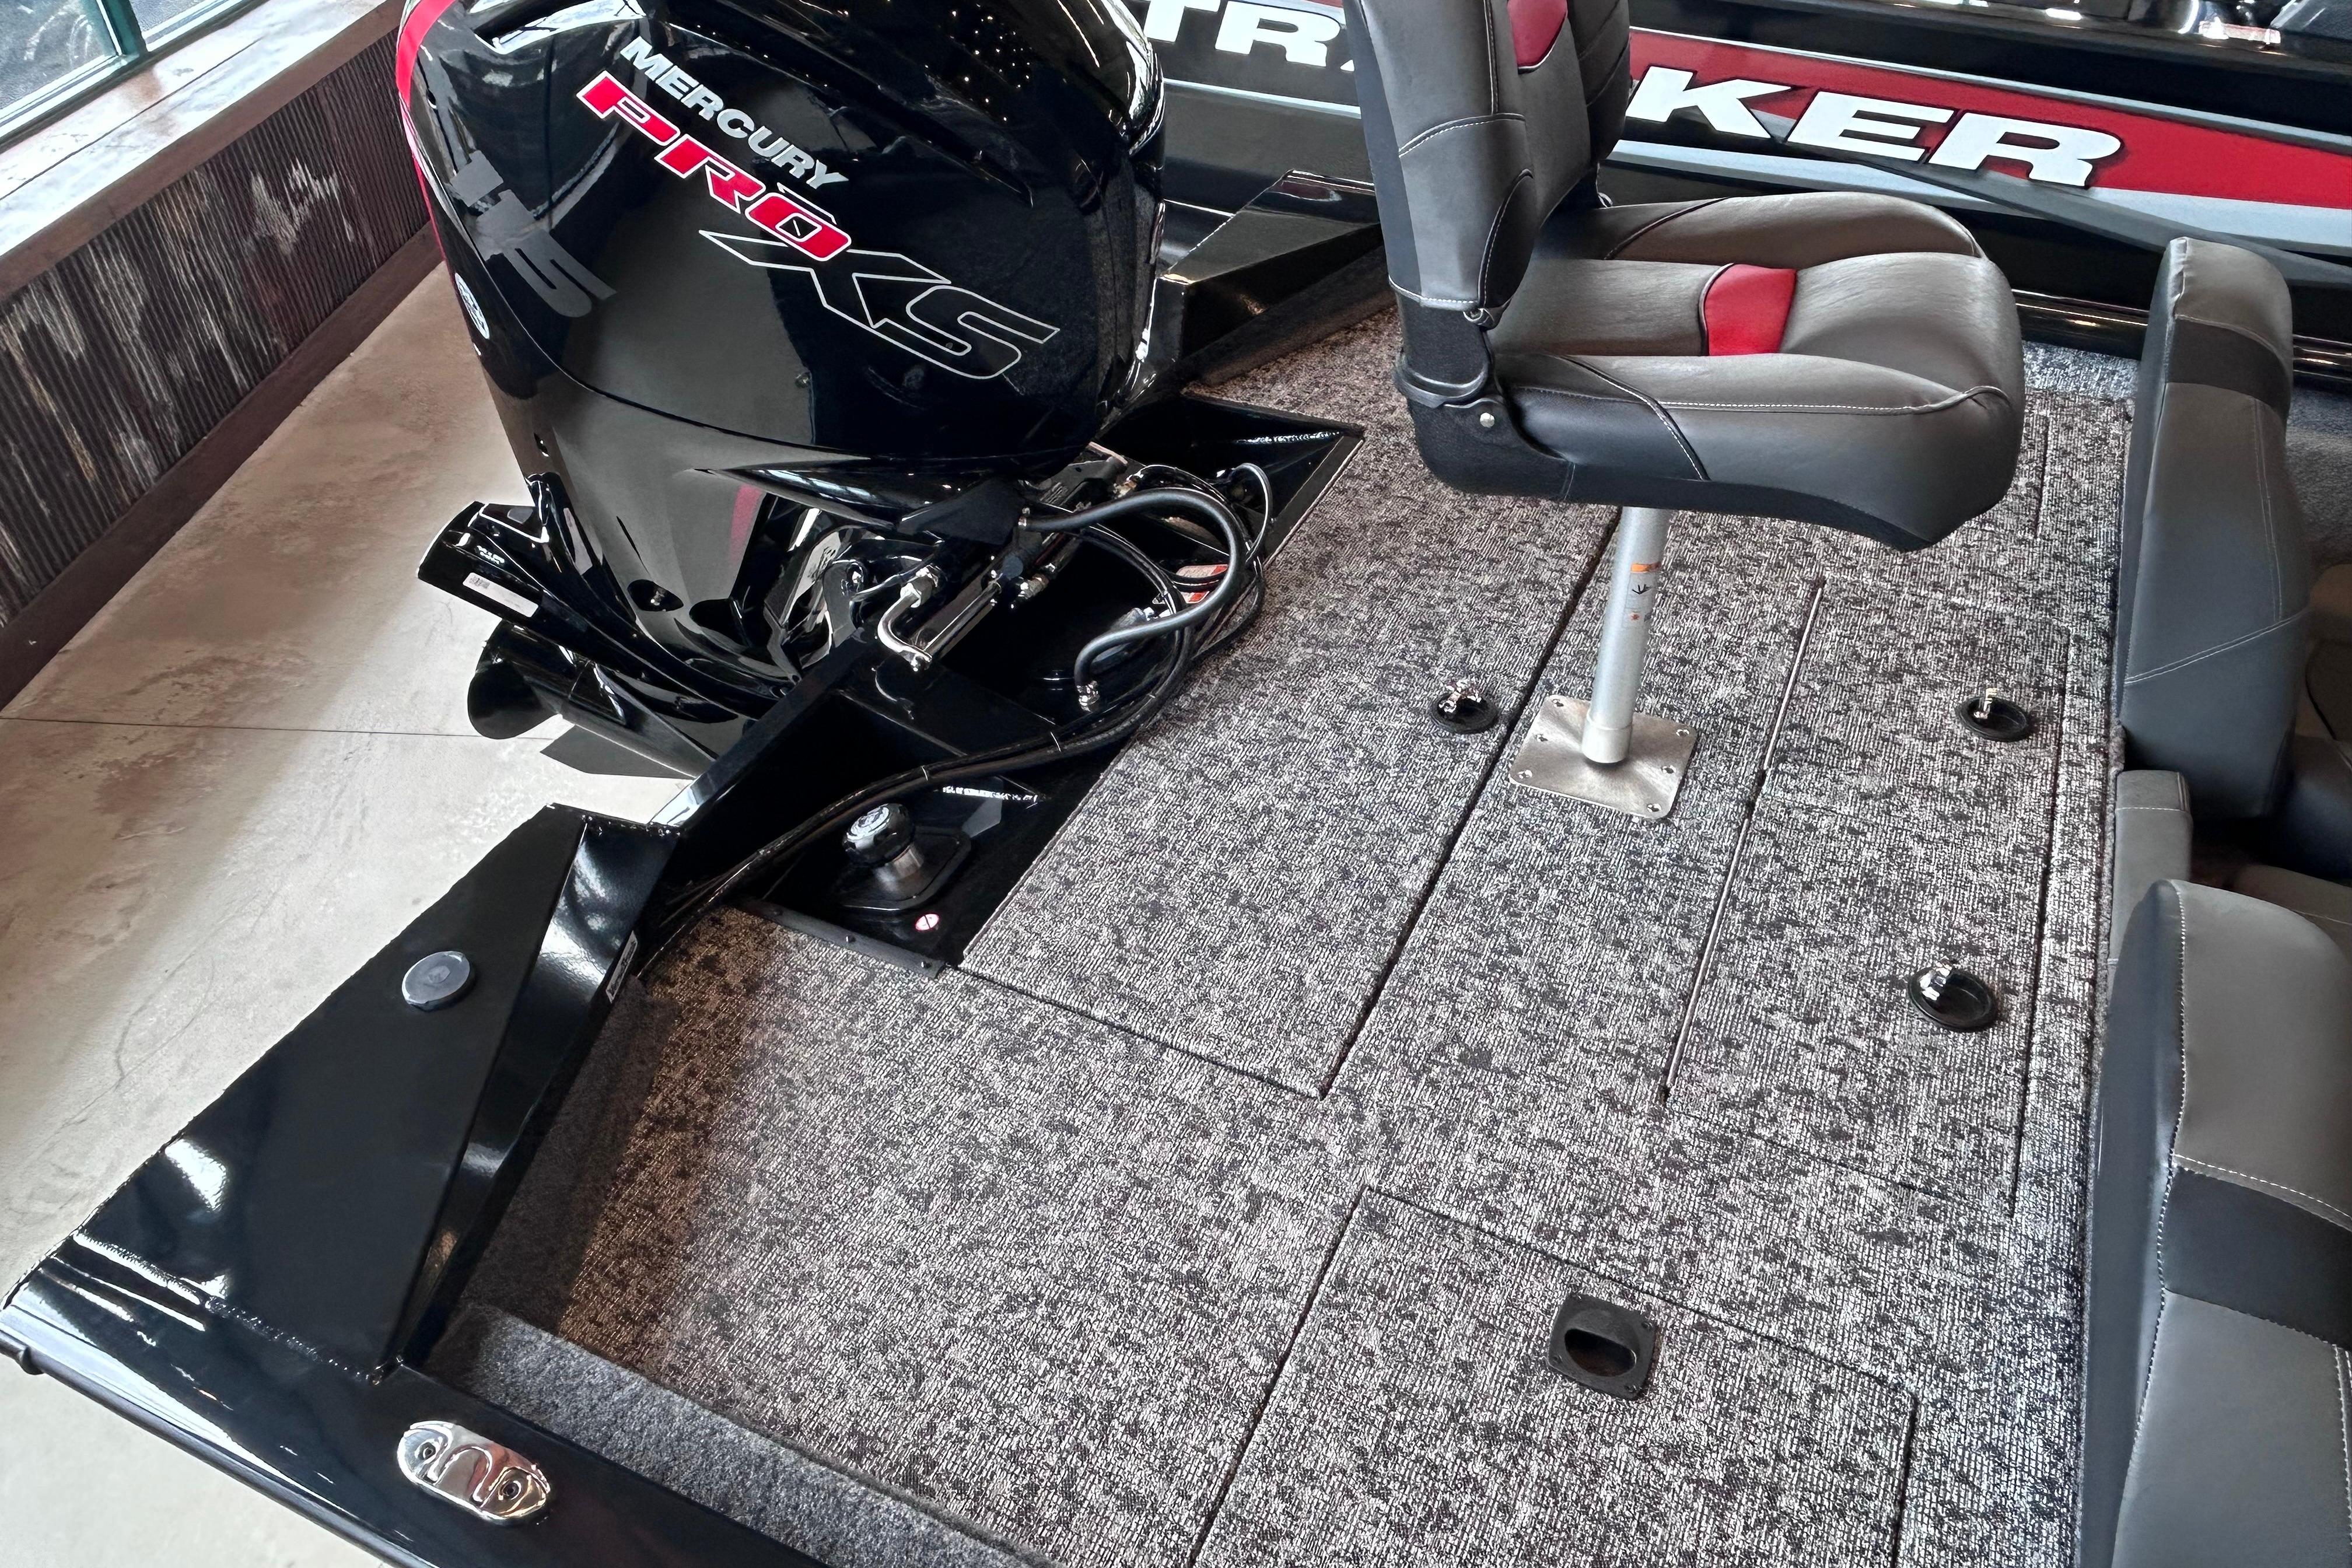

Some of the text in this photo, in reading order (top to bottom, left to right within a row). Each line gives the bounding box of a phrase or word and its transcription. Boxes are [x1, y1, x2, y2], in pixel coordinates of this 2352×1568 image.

[576, 69, 852, 262] PRO
[620, 36, 849, 190] MERCURY
[698, 182, 1060, 380] XS
